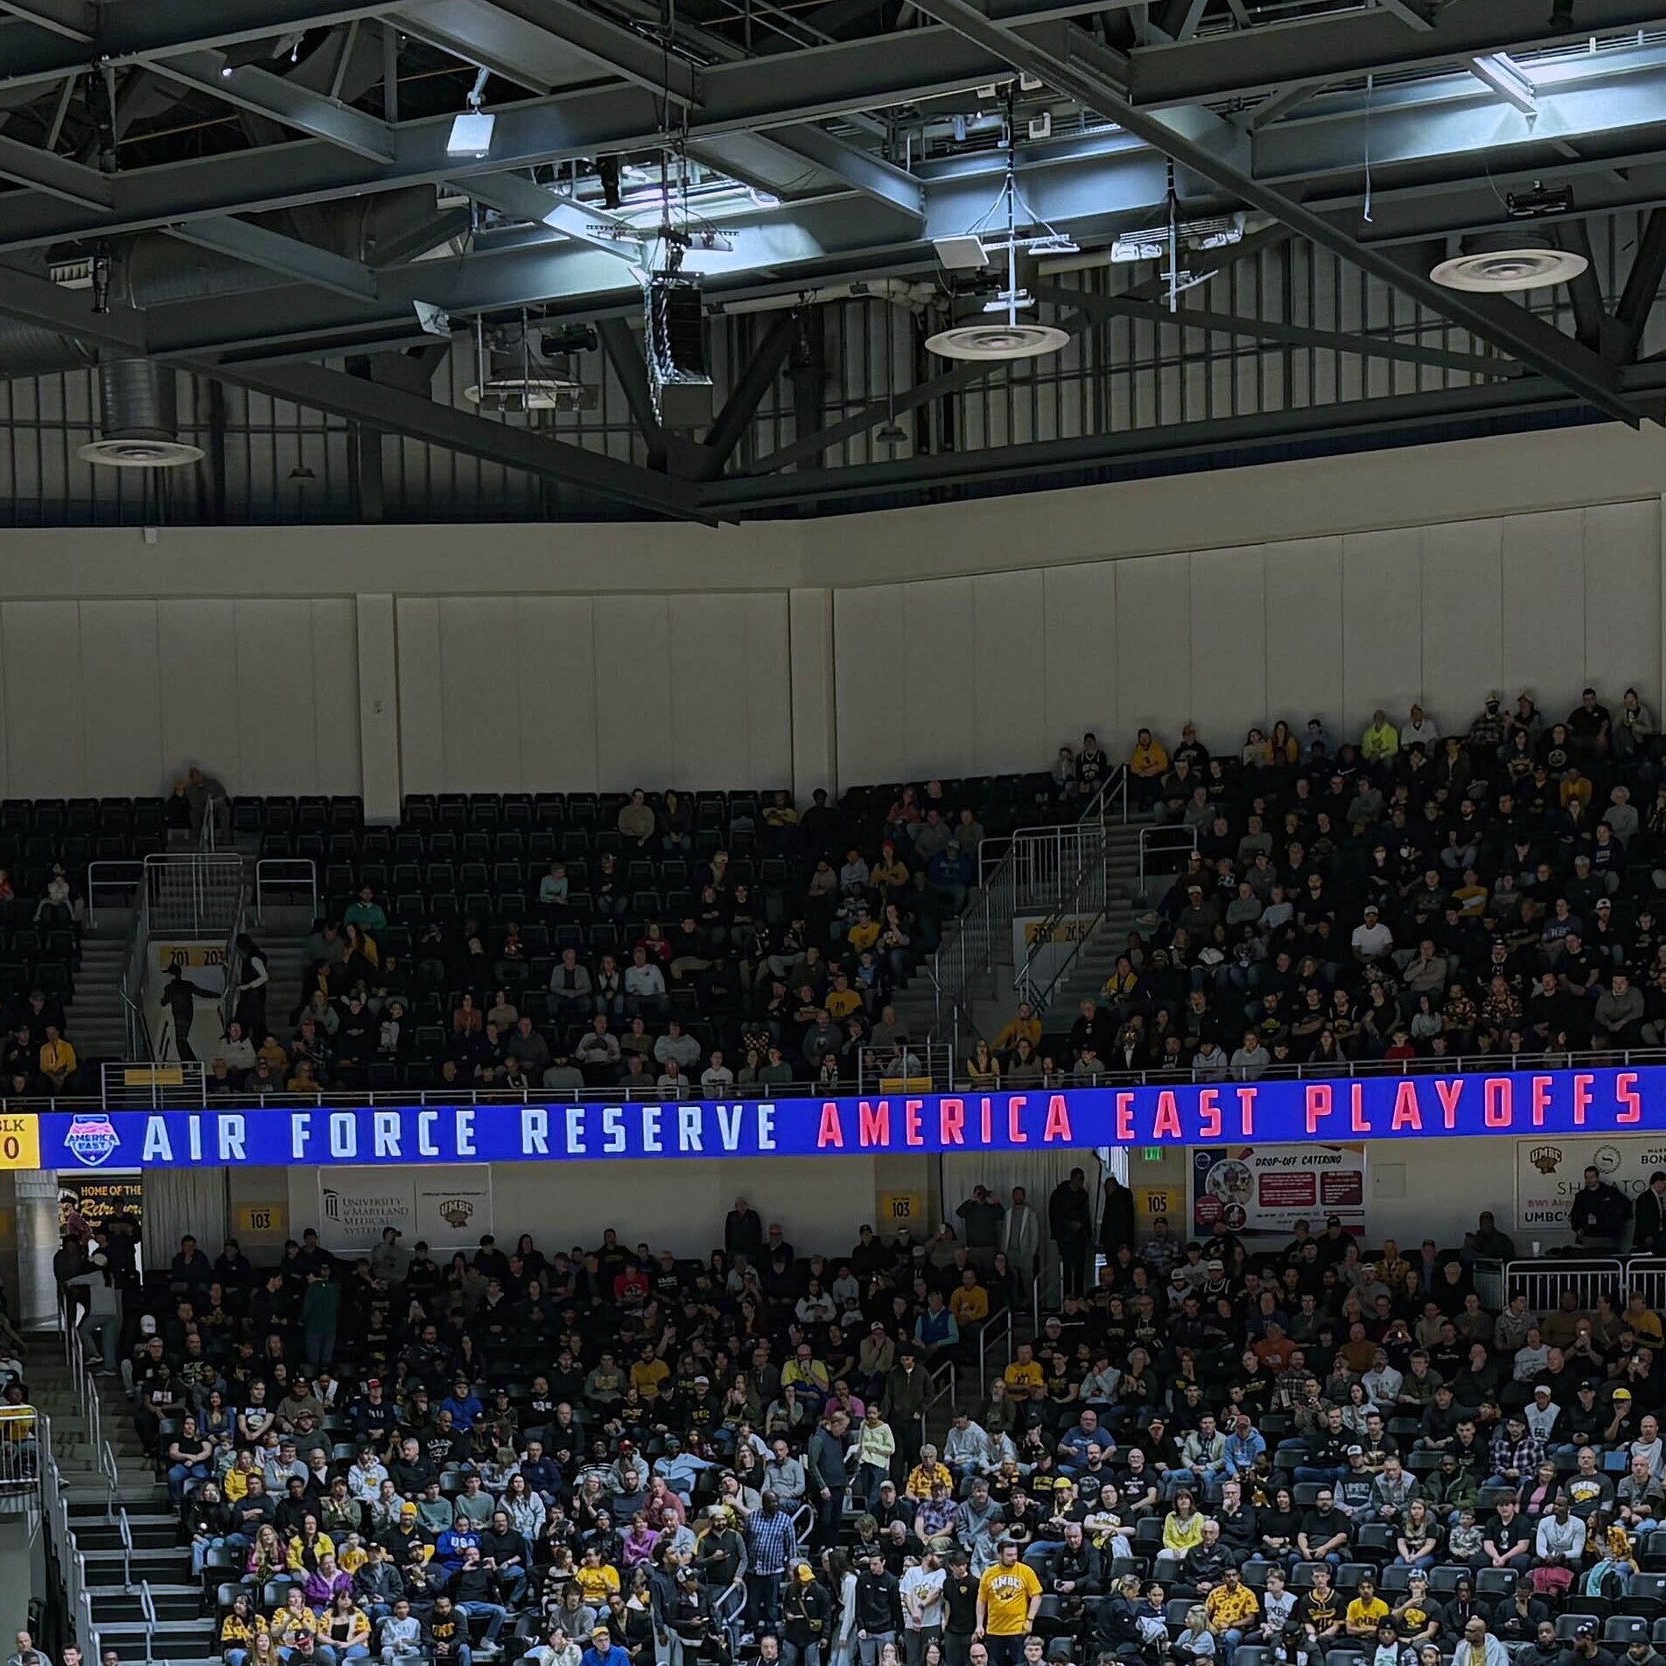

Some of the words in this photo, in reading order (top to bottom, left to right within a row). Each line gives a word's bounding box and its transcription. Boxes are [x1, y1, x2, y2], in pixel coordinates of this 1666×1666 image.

[142, 1114, 247, 1162] AIR
[292, 1109, 477, 1159] FORCE
[521, 1102, 778, 1155] RESERVE
[817, 1094, 1074, 1148] AMERICA
[1117, 1087, 1259, 1140] EAST
[1306, 1072, 1641, 1134] PLAYOFFS
[3, 1136, 20, 1160] 0
[1529, 1146, 1563, 1164] UMBC
[1255, 1156, 1298, 1168] DROP-OFF
[1301, 1155, 1343, 1167] CATERING
[80, 1185, 109, 1198] HOME
[108, 1185, 123, 1197] OF
[122, 1184, 143, 1197] THE
[342, 1197, 402, 1207] UNIVERSITY
[439, 1199, 474, 1217] UMBC
[891, 1200, 912, 1219] 103
[1147, 1196, 1168, 1213] 105
[352, 1206, 410, 1217] MARYLAND
[250, 1213, 271, 1229] 103
[343, 1216, 391, 1226] MEDICAL
[450, 1535, 476, 1549] USA
